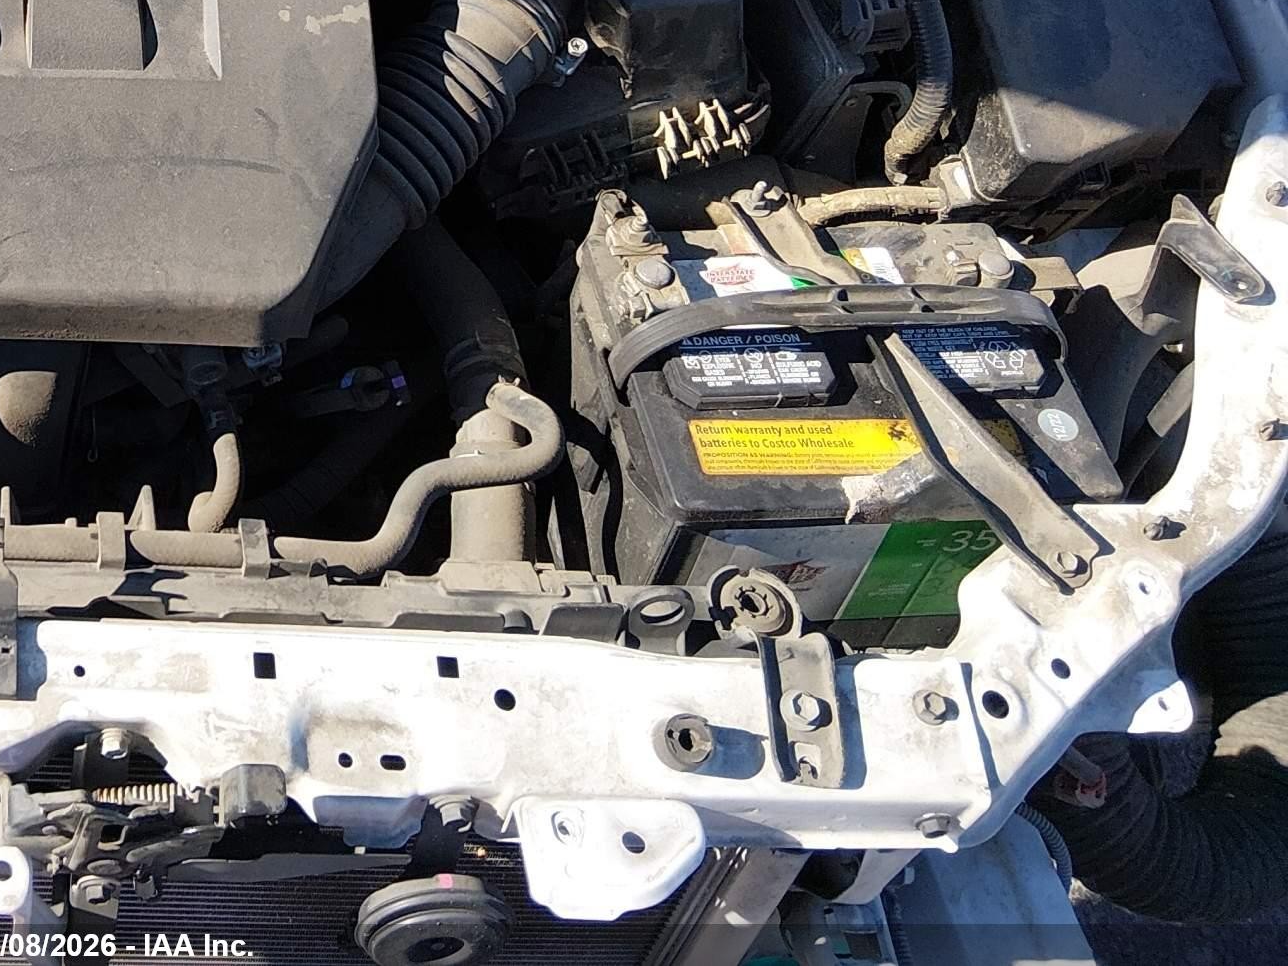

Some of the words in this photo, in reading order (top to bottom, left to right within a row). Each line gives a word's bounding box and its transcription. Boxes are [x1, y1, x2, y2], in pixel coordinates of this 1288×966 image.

[693, 335, 744, 346] DANGER
[755, 334, 801, 344] POISON
[696, 424, 731, 435] Return
[733, 425, 782, 437] warranty
[784, 425, 804, 435] and
[807, 425, 833, 435] used
[700, 438, 747, 448] batteries
[749, 439, 760, 448] to
[762, 438, 797, 449] Costco
[799, 438, 855, 448] Wholesale
[942, 530, 998, 552] 35
